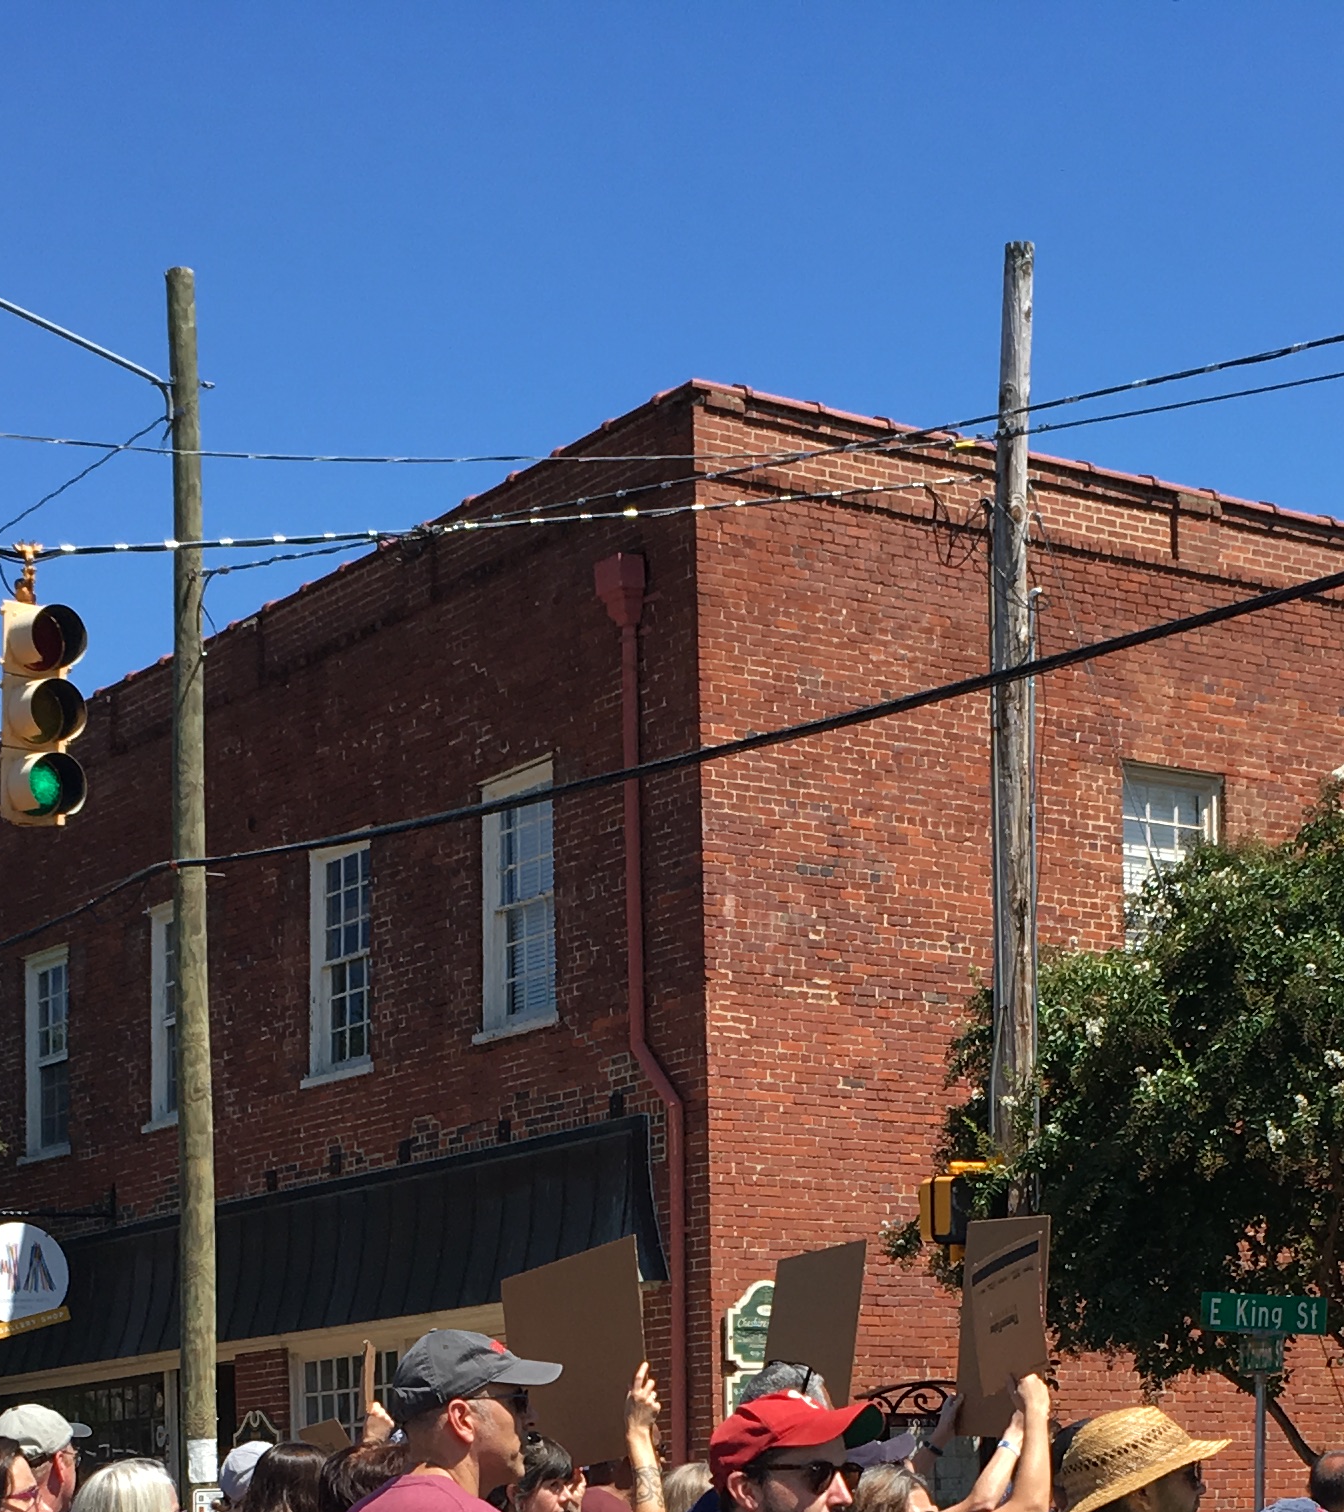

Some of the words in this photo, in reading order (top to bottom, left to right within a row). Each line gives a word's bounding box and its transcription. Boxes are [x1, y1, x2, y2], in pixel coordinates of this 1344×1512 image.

[41, 1312, 65, 1323] SHOP
[1209, 1298, 1222, 1326] E
[1236, 1298, 1283, 1329] King
[1296, 1302, 1319, 1330] St
